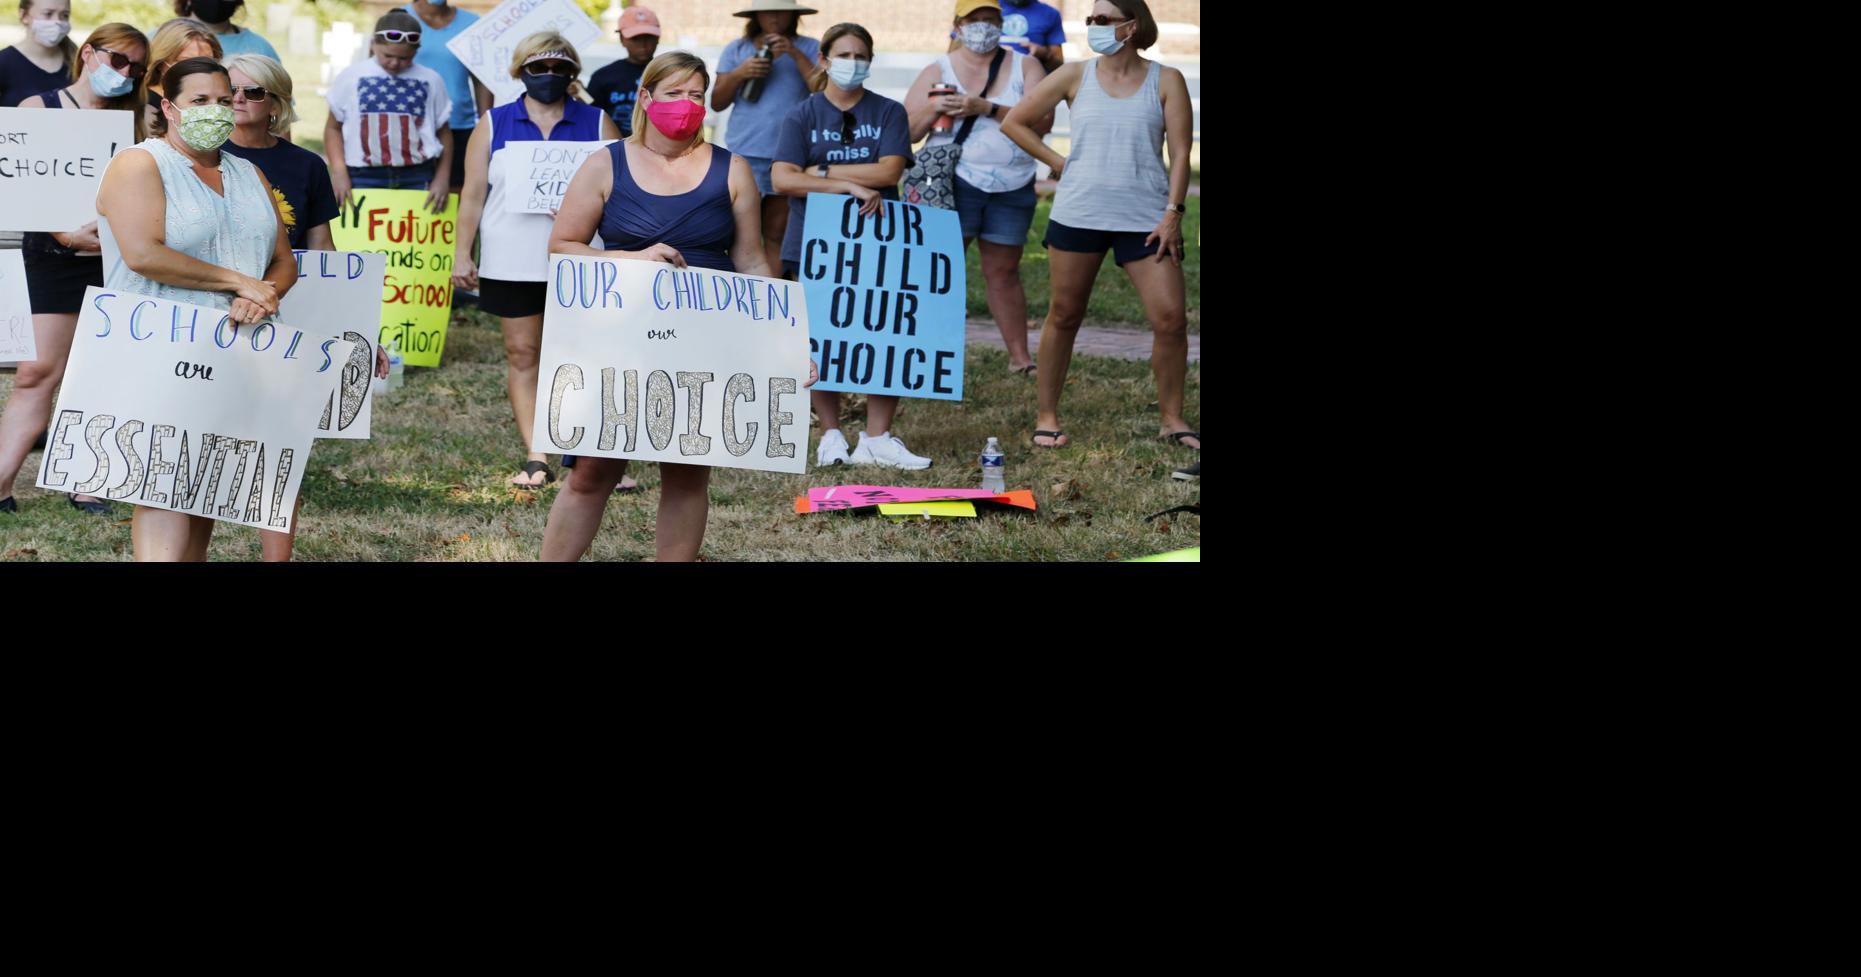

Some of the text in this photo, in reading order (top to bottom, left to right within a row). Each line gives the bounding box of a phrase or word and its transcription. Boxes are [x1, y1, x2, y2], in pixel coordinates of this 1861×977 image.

[483, 0, 547, 41] SCHOOL
[811, 124, 881, 143] I toally
[826, 145, 870, 161] miss
[368, 208, 454, 245] Future
[841, 198, 924, 246] OUR
[430, 253, 452, 271] on
[804, 238, 951, 295] CHILD
[382, 275, 451, 307] School
[556, 258, 796, 326] OUR CHILDREN,
[830, 286, 919, 336] OUR
[93, 293, 338, 373] SCHOOLS
[647, 328, 678, 340] our
[174, 360, 214, 381] are
[548, 363, 797, 458] CHOICE
[43, 409, 294, 528] ESSENTIAL
